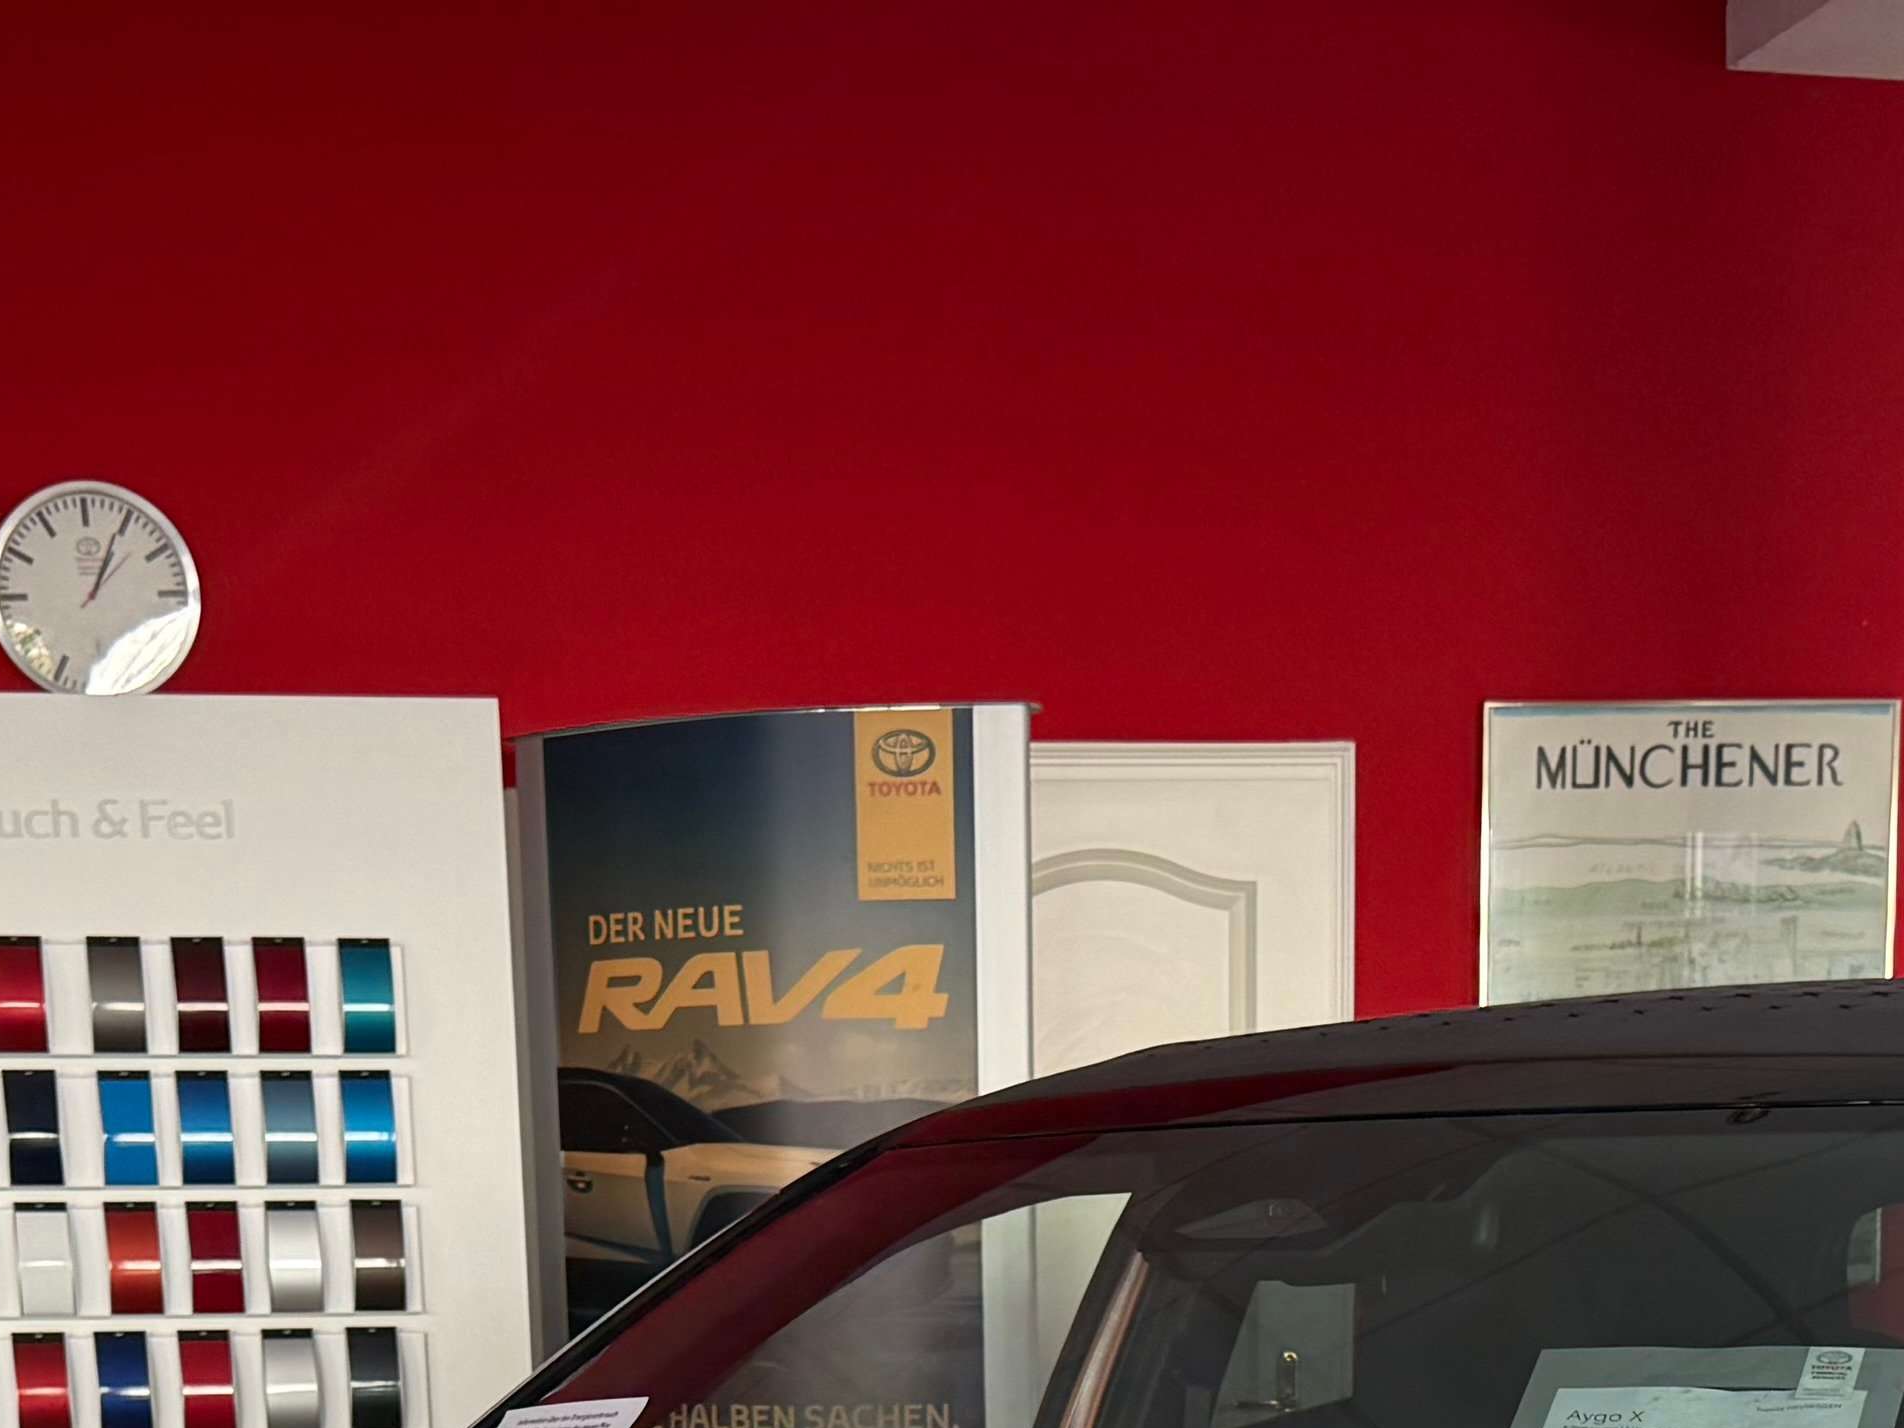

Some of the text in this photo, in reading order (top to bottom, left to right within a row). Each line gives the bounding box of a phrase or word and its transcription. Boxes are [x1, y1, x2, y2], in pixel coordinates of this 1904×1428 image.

[1667, 719, 1716, 740] THE
[1535, 739, 1845, 791] MÜNCHENER
[866, 780, 942, 798] TOYOTA
[92, 800, 128, 841] &
[140, 798, 236, 842] Feel
[866, 859, 936, 873] NICHTS IST
[587, 904, 745, 945] DER NEUE
[576, 943, 951, 1035] RAV4
[1565, 1408, 1646, 1425] Aygo X
